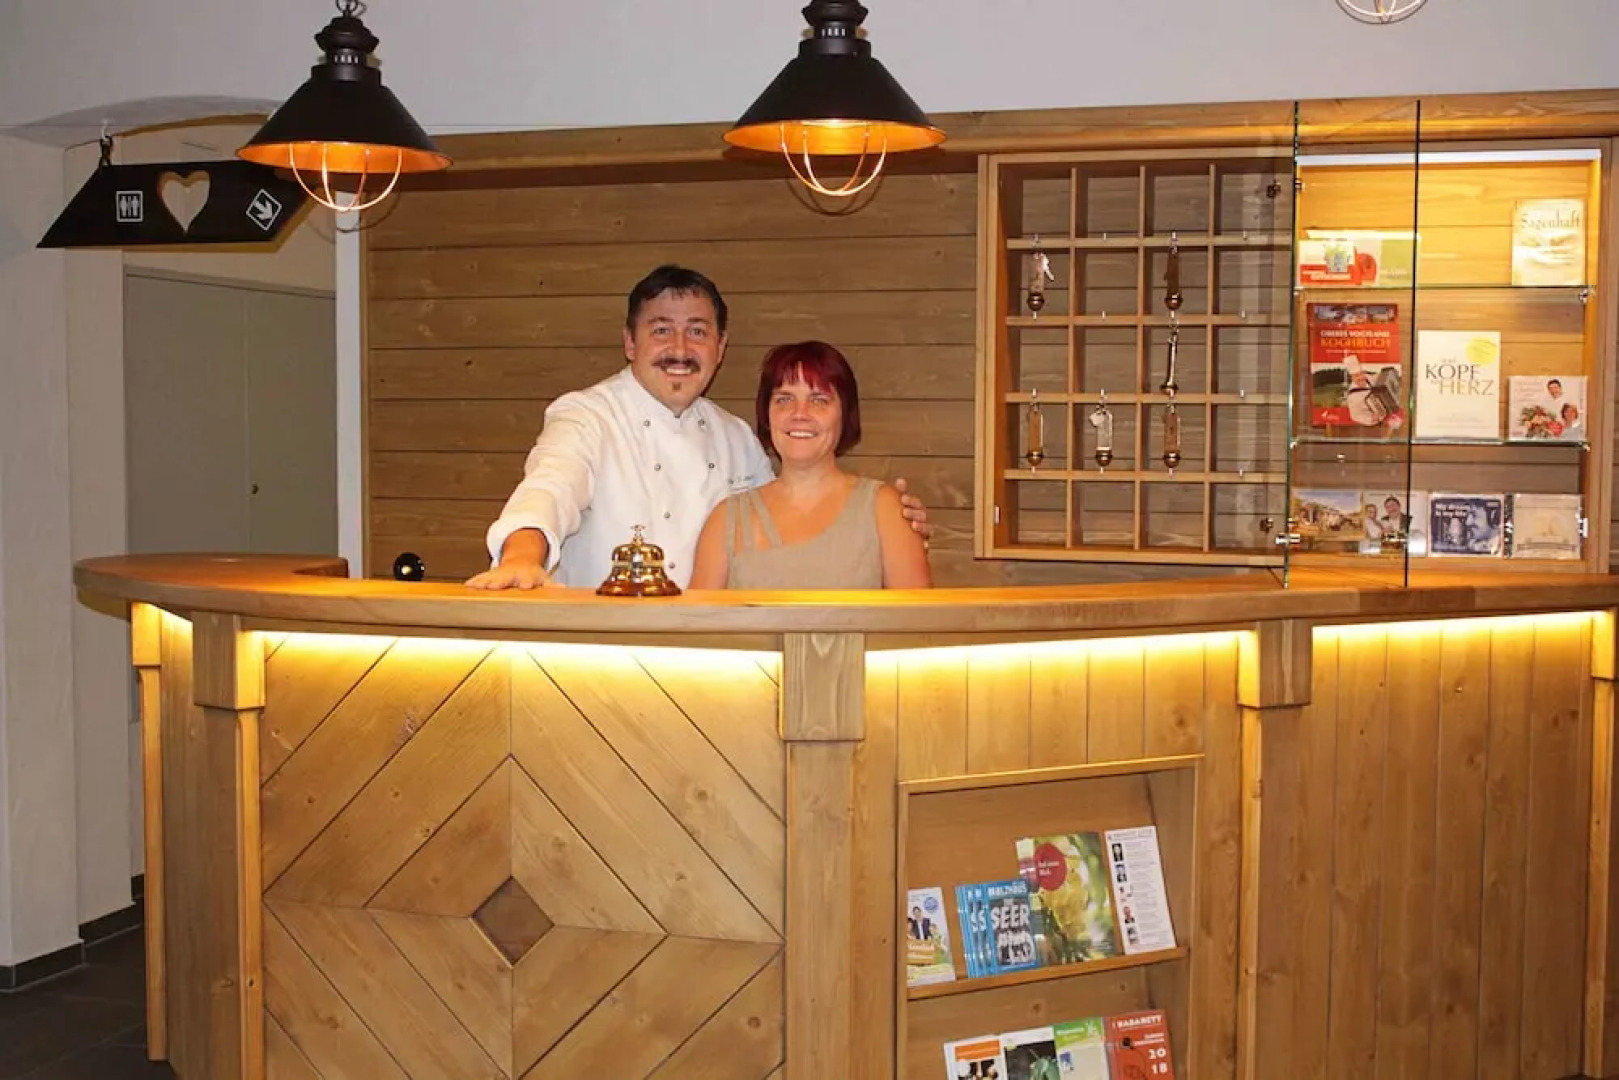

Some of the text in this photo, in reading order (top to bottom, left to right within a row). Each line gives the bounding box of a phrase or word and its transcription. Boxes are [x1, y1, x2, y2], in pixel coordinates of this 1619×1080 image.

[1521, 209, 1580, 231] Sagenhaft
[1320, 338, 1391, 348] KOCHBUCH
[1425, 363, 1481, 380] KOPF
[1439, 379, 1495, 395] HERZ
[990, 904, 1029, 930] SEER
[1117, 1014, 1162, 1029] KABARETT
[1149, 1047, 1167, 1060] 20
[1152, 1061, 1168, 1075] 18
